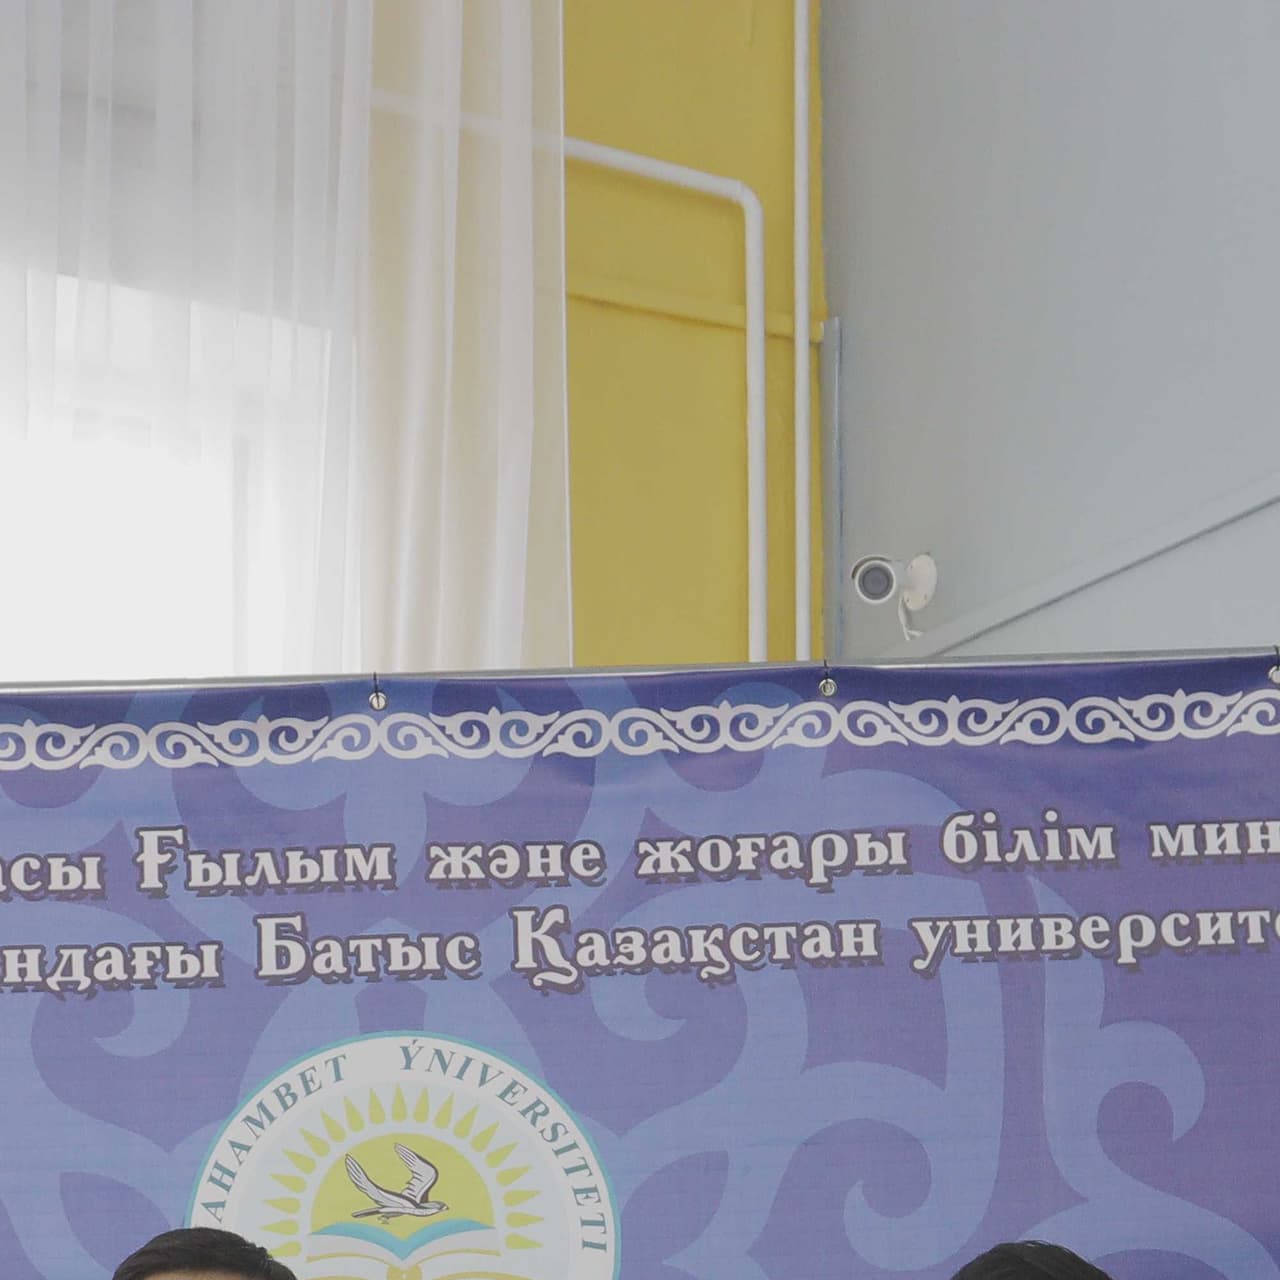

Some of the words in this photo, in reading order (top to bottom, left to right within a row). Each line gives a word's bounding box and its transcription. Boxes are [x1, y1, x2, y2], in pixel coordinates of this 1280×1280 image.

[134, 826, 393, 890] Ғылым
[428, 840, 604, 884] және
[637, 828, 905, 885] жоғары
[943, 810, 1115, 863] білім
[256, 914, 480, 978] Батыс
[511, 907, 880, 985] Қазақстан
[200, 1053, 348, 1222] AHAMBET
